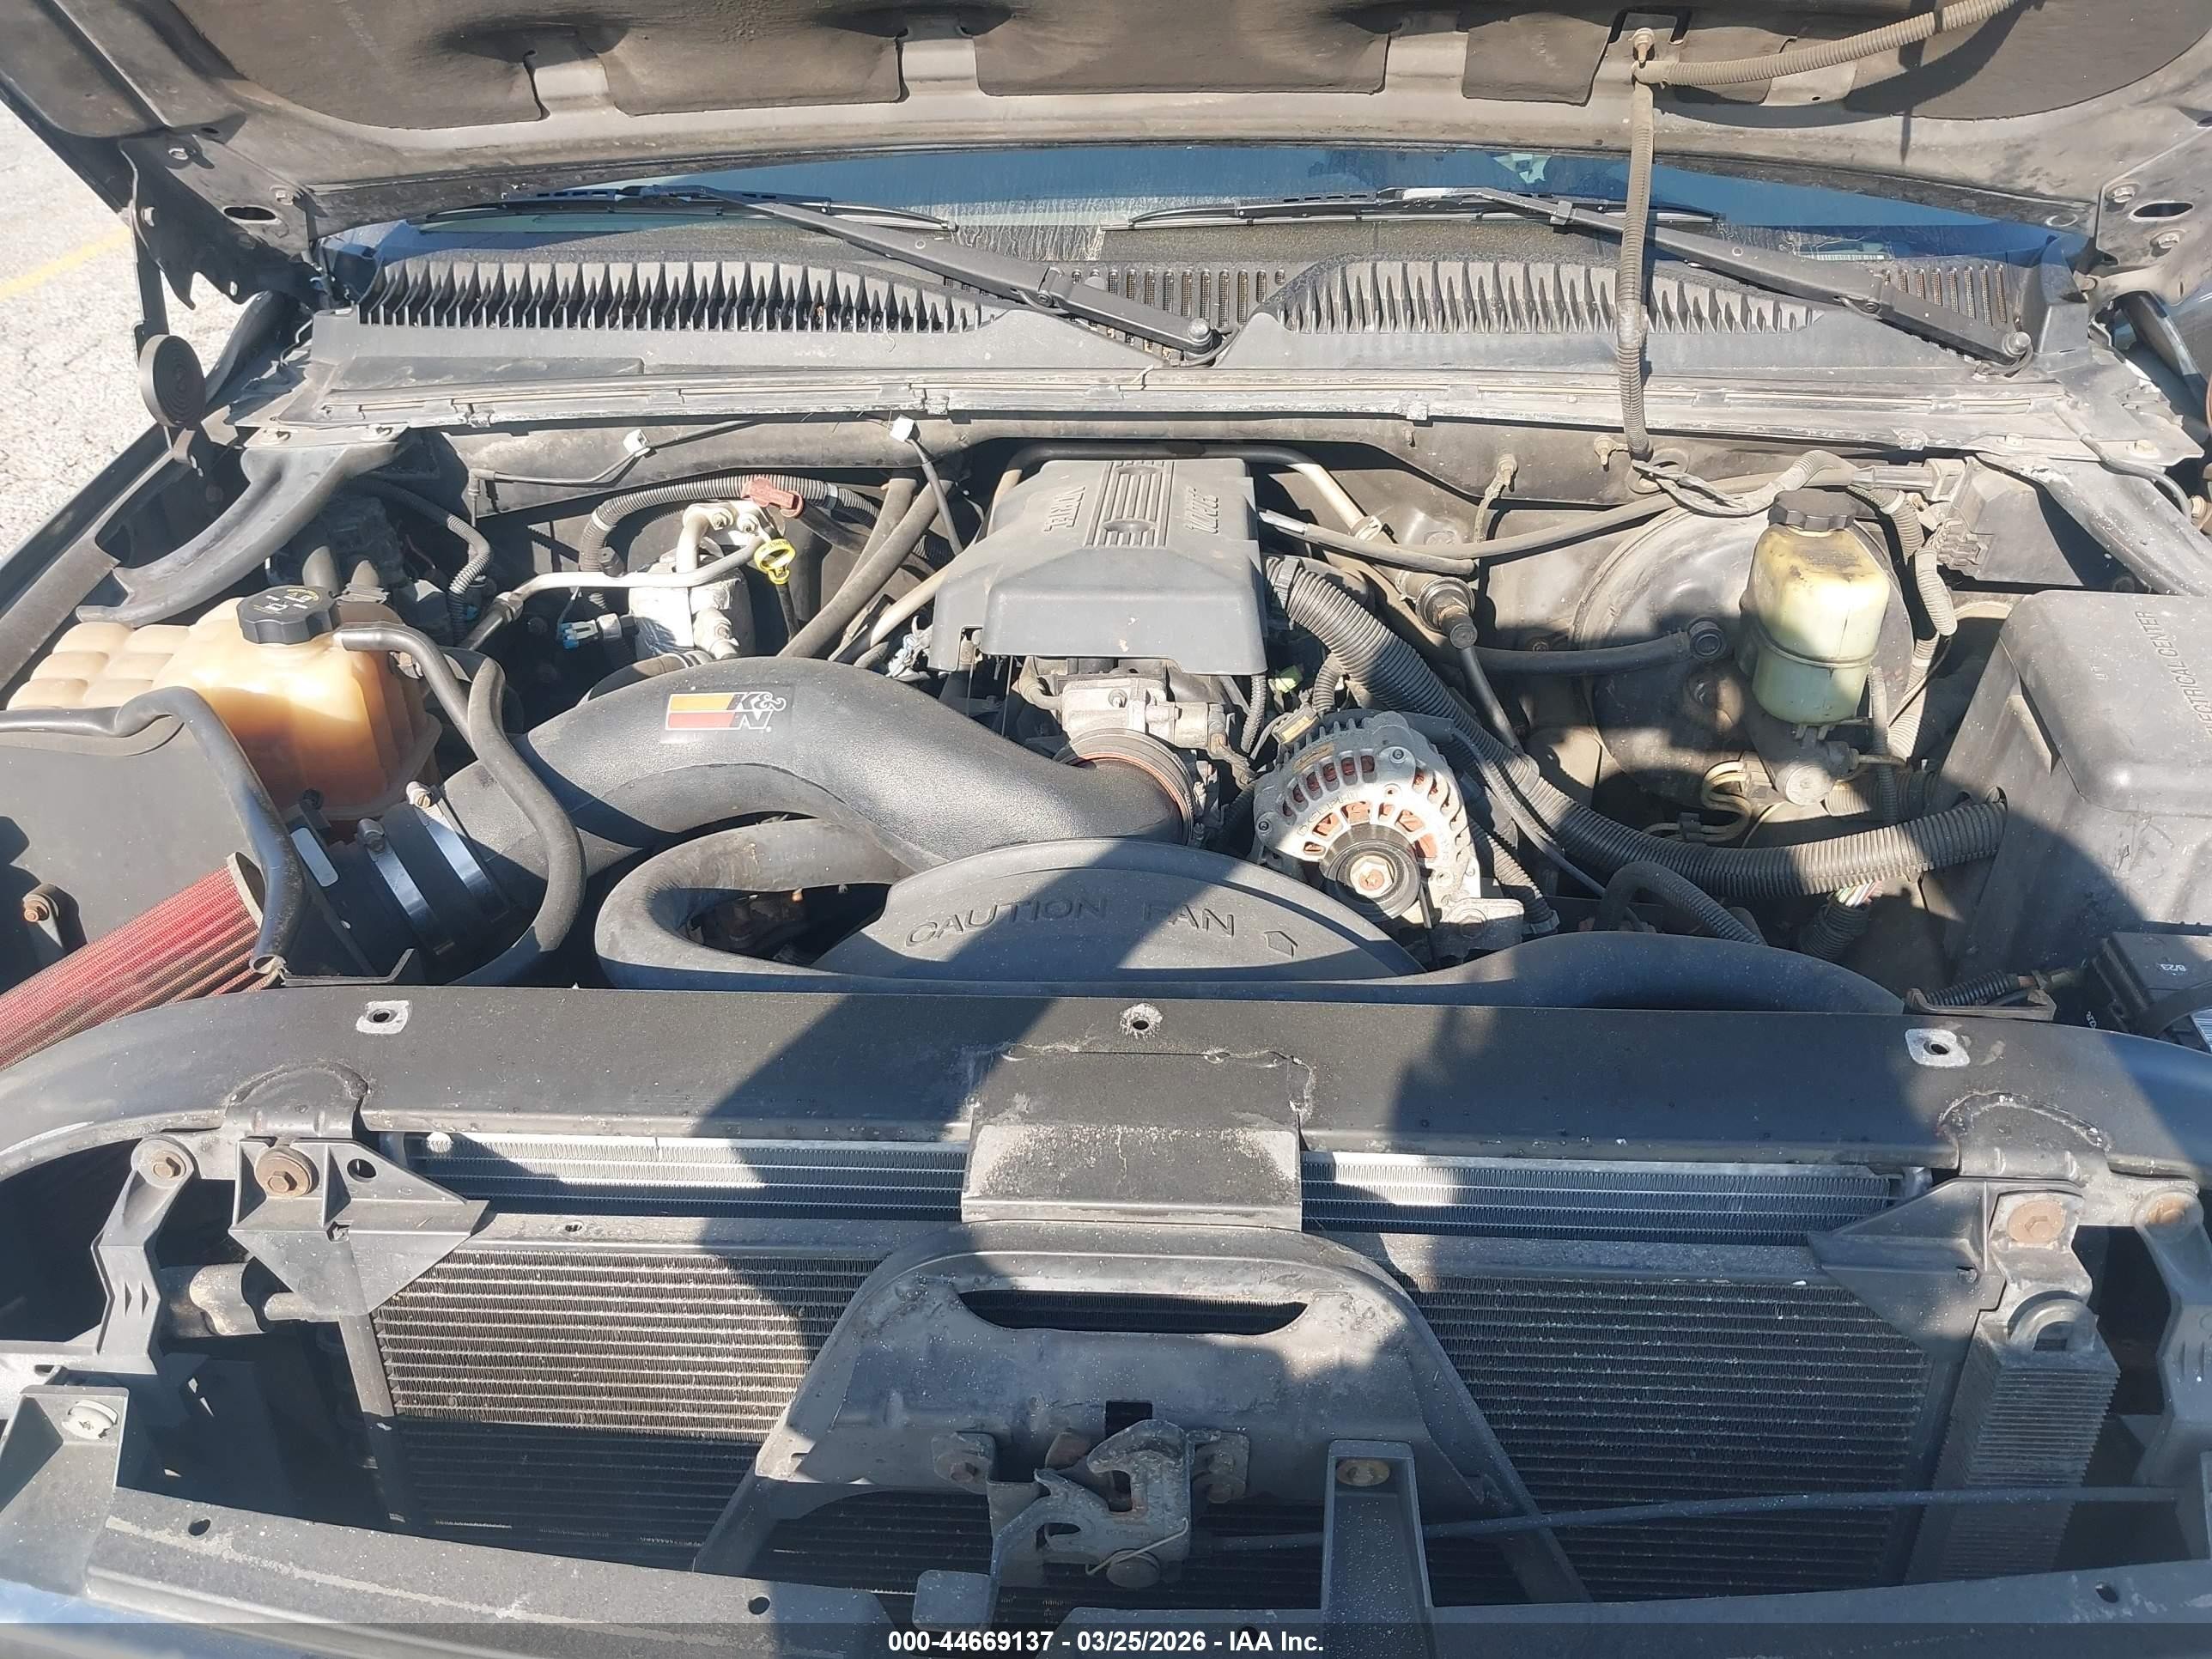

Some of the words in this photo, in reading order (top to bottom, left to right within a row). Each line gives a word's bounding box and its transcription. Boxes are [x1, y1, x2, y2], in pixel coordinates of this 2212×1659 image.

[1043, 485, 1086, 532] VORTEC
[2135, 610, 2179, 658] CENTER
[904, 896, 1108, 947] CAUTION
[1143, 899, 1236, 938] FAN
